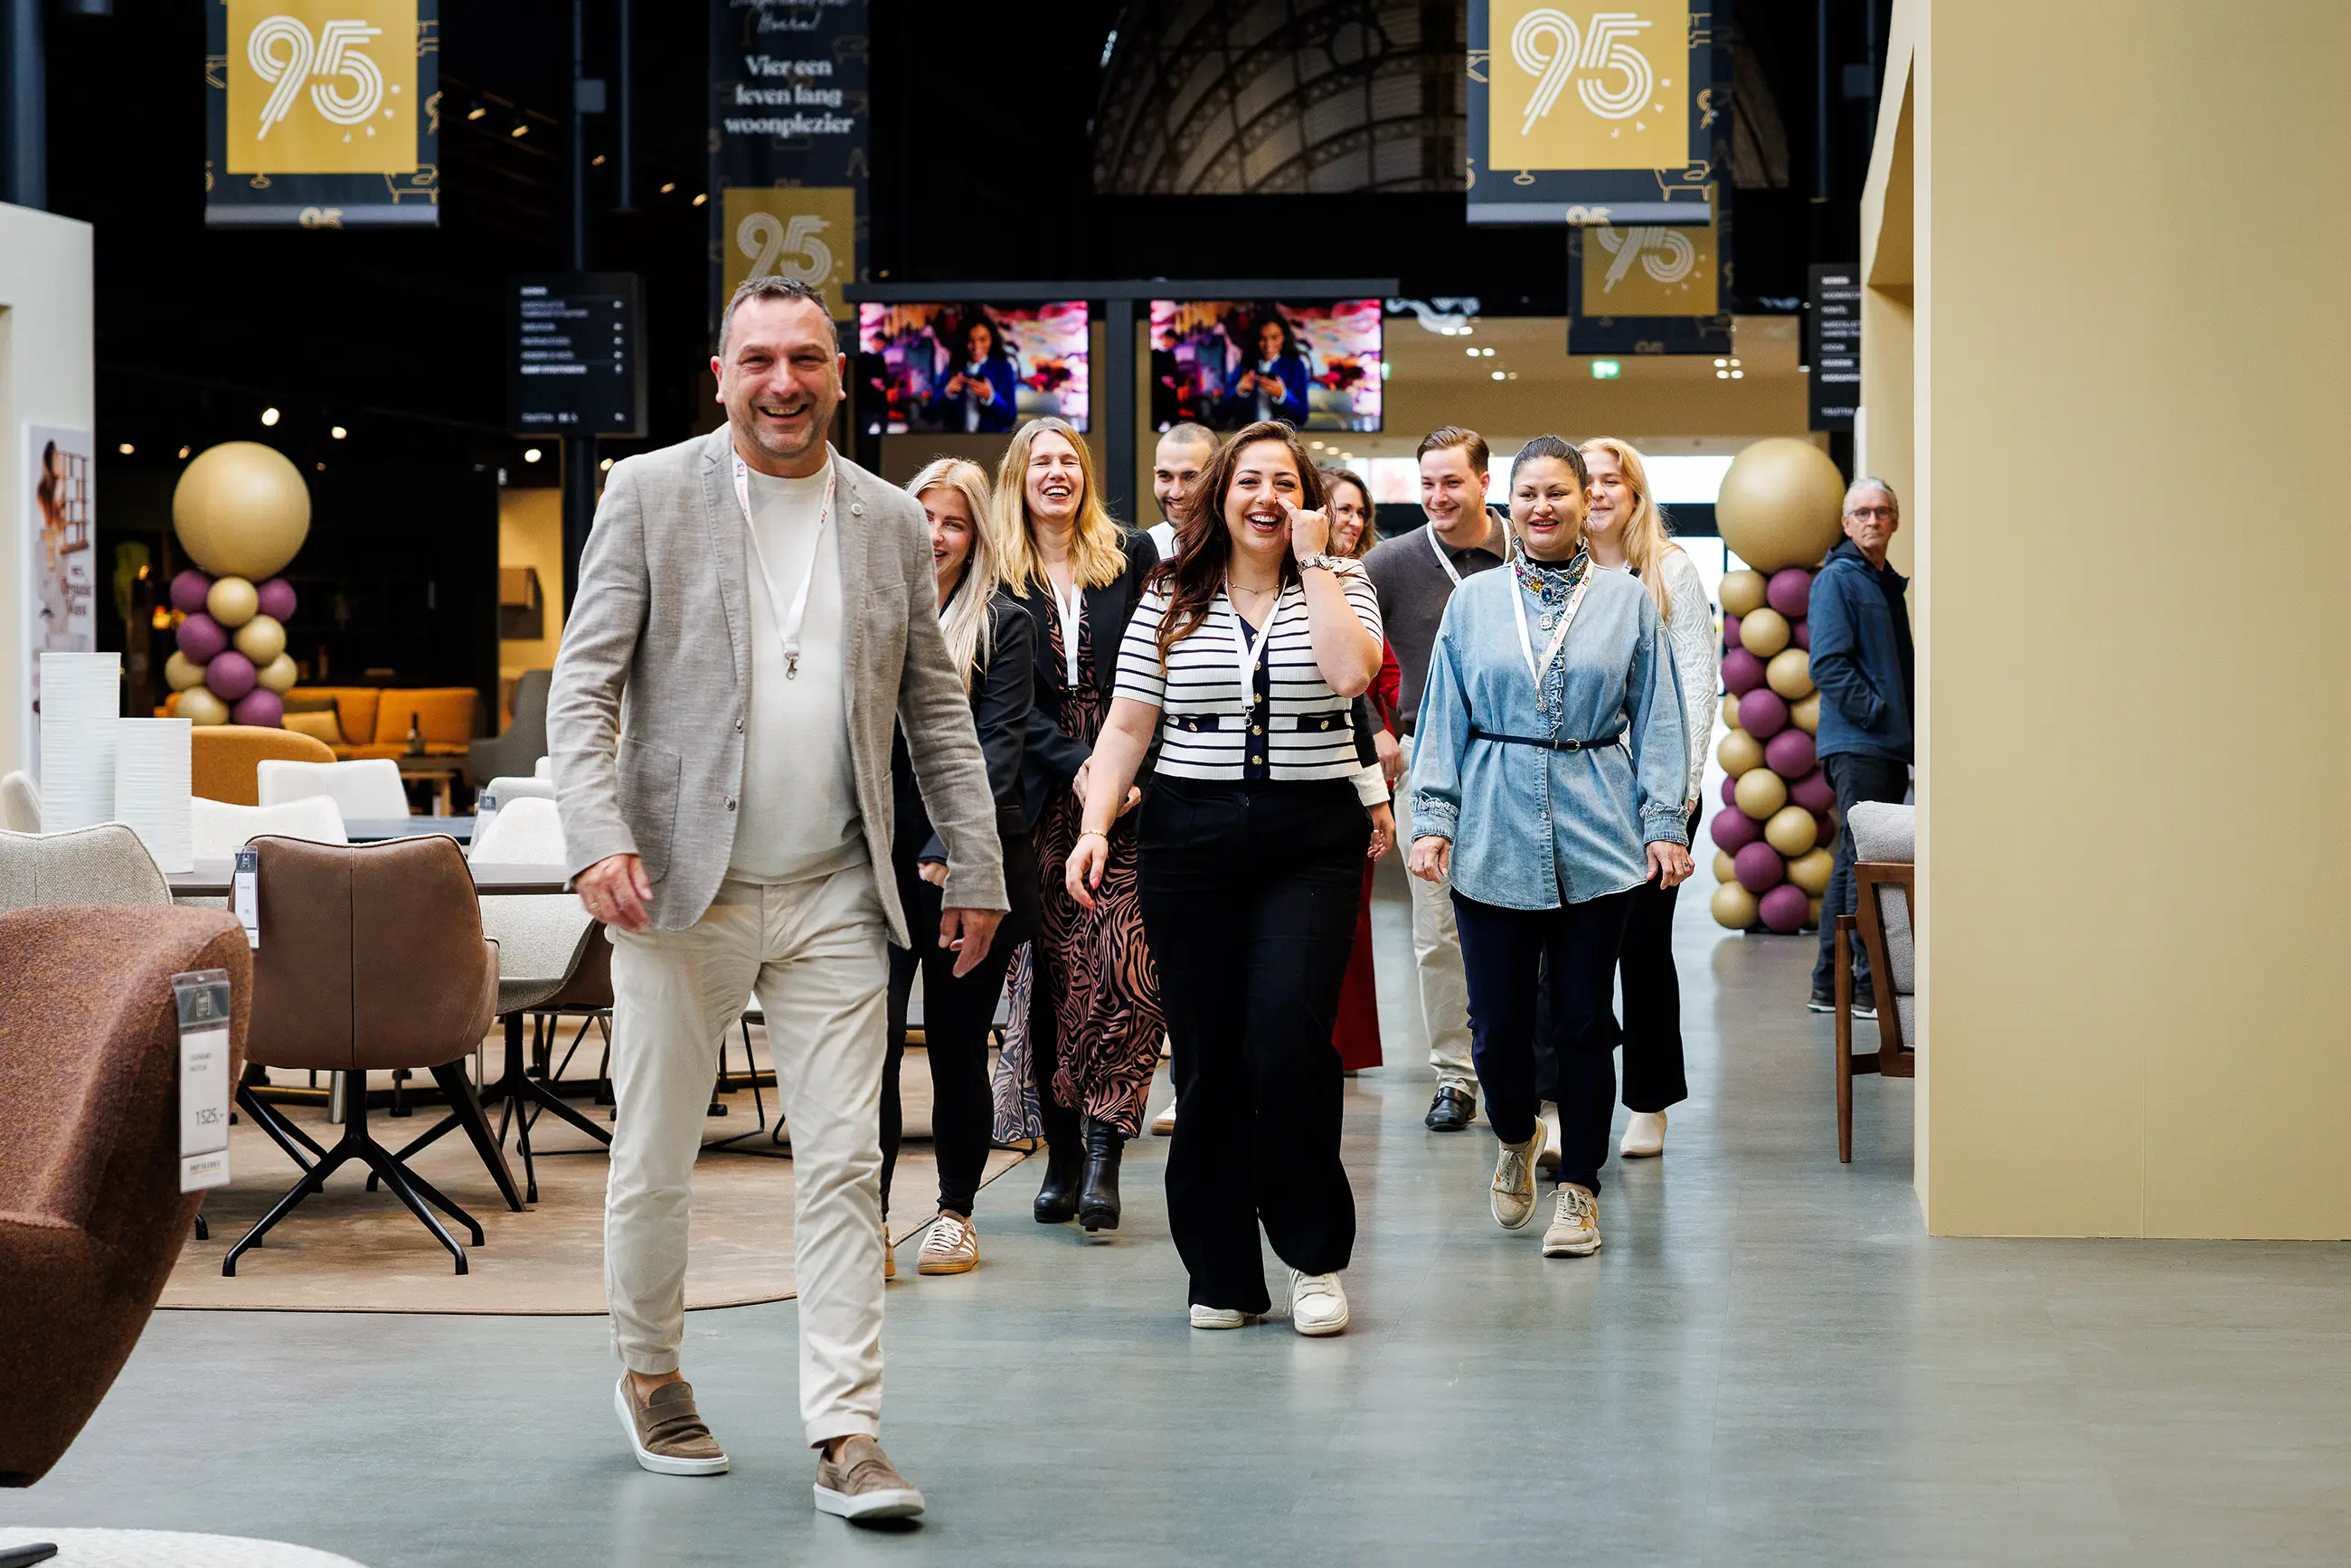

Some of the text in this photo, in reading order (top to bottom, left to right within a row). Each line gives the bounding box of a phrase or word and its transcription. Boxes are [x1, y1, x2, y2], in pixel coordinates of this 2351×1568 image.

[247, 14, 383, 141] 95
[745, 54, 833, 76] Vier een
[1511, 8, 1653, 137] 95
[735, 83, 843, 109] leven lang
[724, 111, 854, 138] woonplezier
[736, 213, 832, 288] 95
